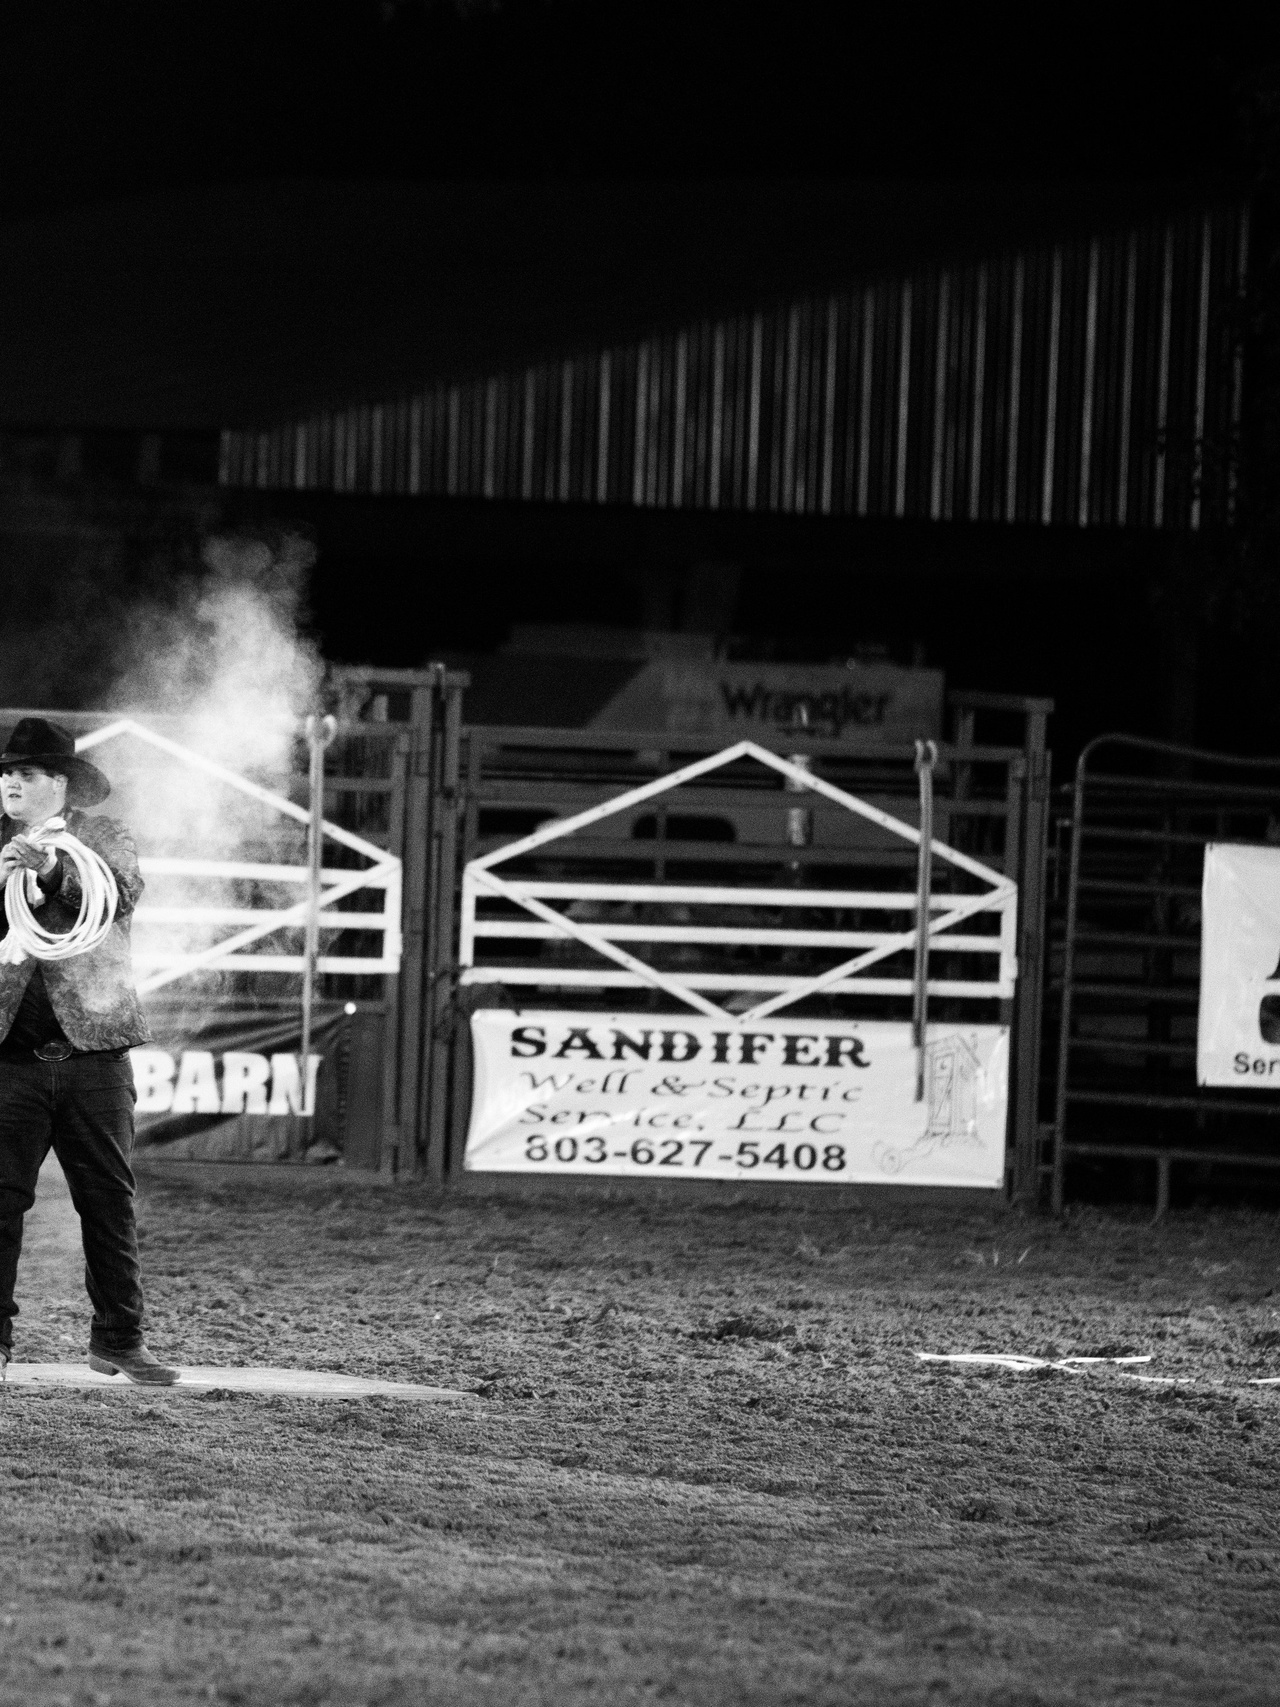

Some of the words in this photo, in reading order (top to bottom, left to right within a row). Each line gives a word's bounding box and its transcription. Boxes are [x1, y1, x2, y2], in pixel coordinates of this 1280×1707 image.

[509, 1026, 871, 1069] SANDIFER
[519, 1068, 644, 1096] Well
[650, 1073, 707, 1098] &
[706, 1074, 864, 1109] Septic
[726, 1110, 848, 1134] LLC
[524, 1135, 848, 1173] 803-627-5408
